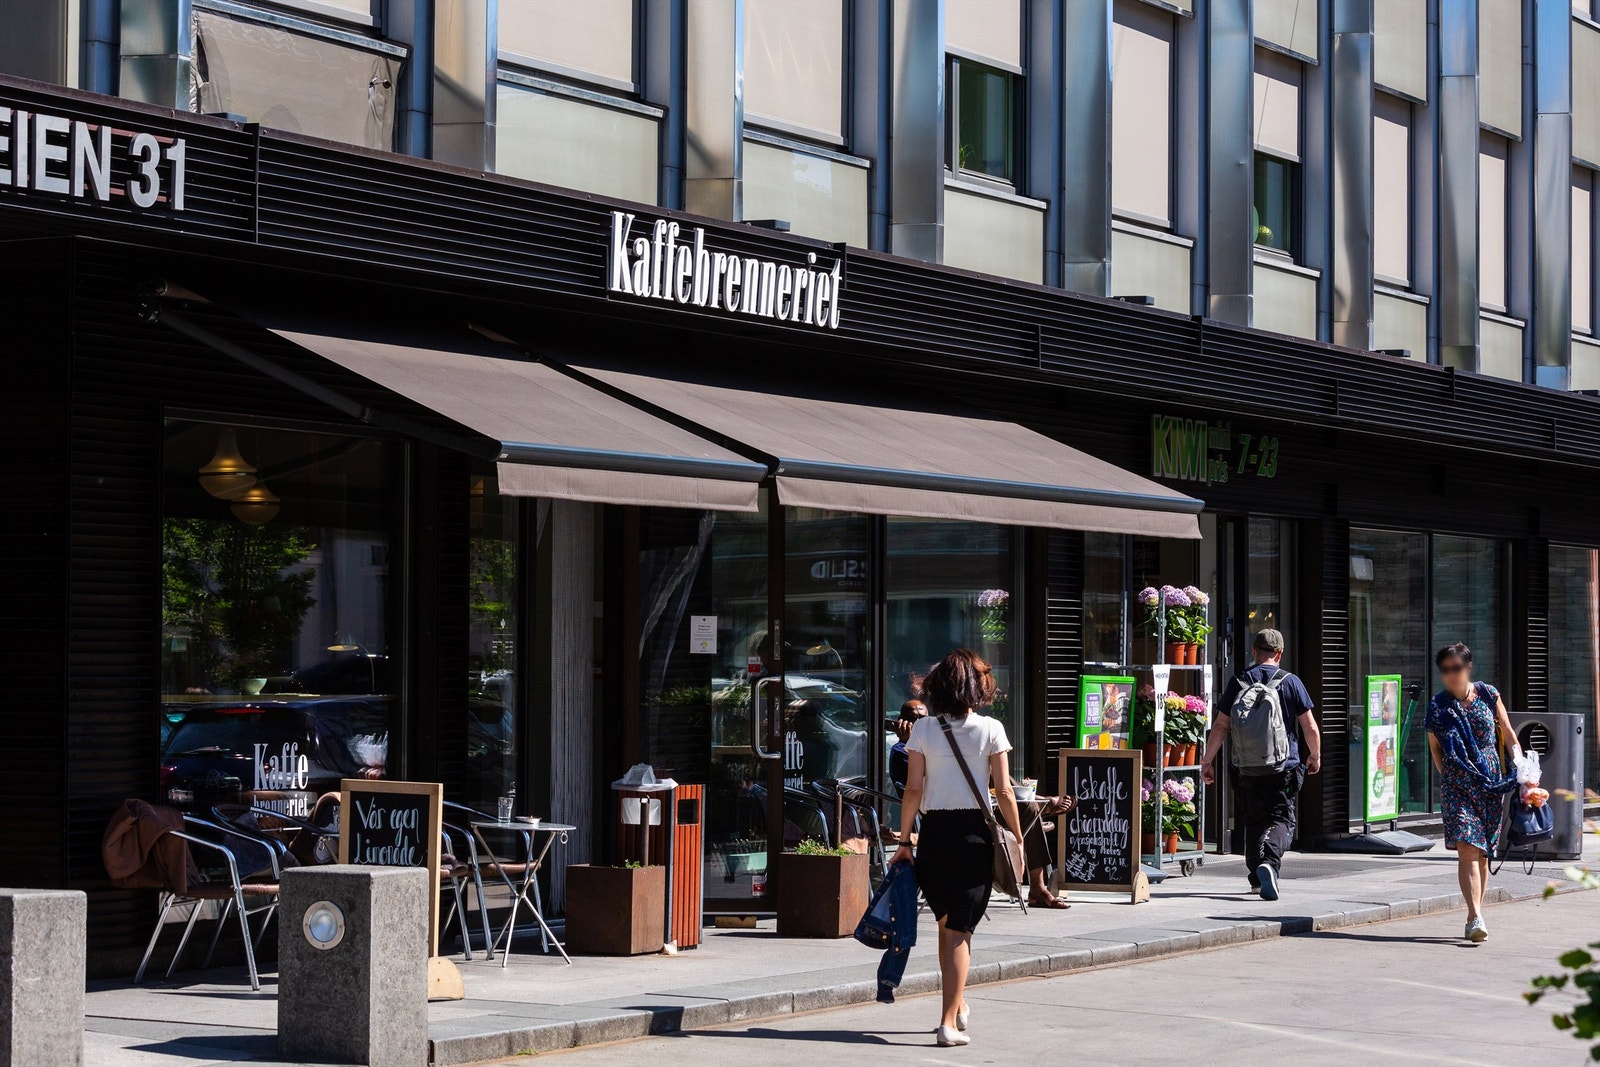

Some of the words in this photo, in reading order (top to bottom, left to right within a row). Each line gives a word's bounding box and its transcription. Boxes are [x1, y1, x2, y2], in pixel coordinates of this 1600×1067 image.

[127, 133, 186, 211] 31
[608, 210, 842, 330] Kaffebrenneriet
[1152, 414, 1208, 482] KIWI
[1207, 454, 1229, 487] pris
[253, 742, 309, 790] Kaffe
[253, 794, 309, 818] brenneriet
[355, 796, 386, 829] Vår
[390, 808, 420, 847] egen
[354, 833, 423, 866] Limonade
